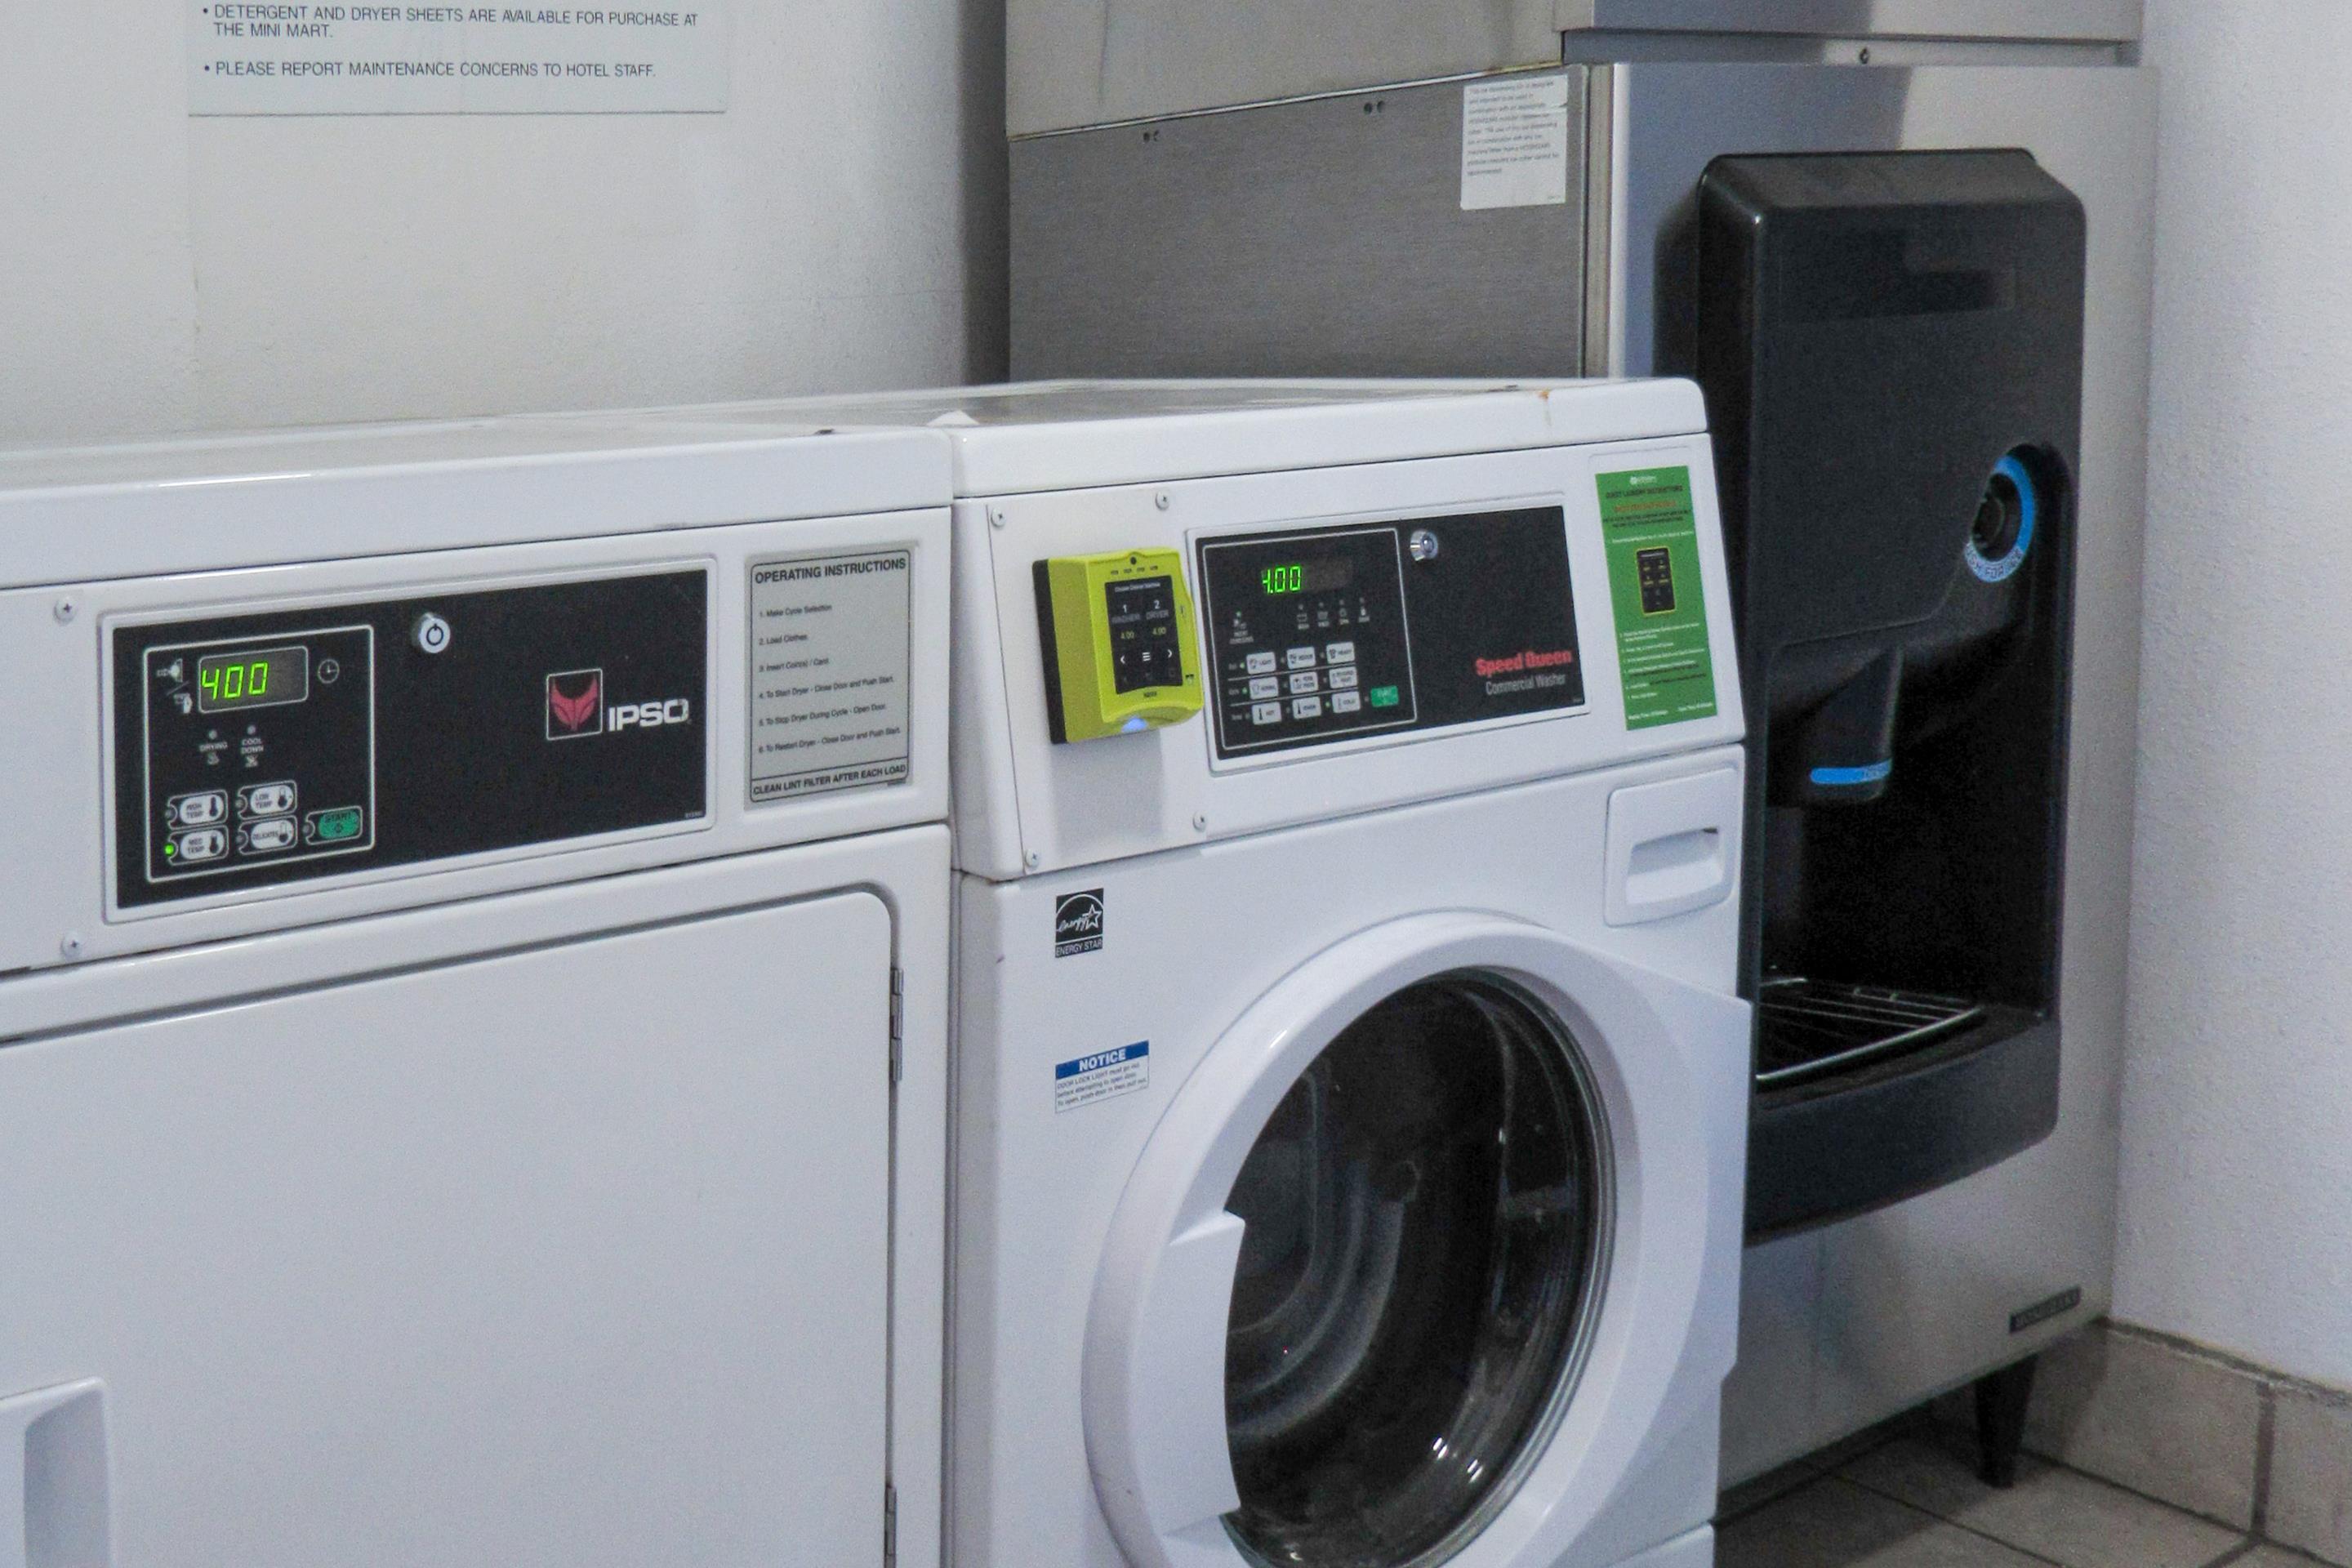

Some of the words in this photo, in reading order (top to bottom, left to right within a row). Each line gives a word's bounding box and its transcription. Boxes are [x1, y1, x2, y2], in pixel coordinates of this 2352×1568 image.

[214, 5, 308, 20] DETERGENT
[314, 6, 345, 20] AND
[351, 7, 401, 21] DRYER
[406, 7, 464, 22] SHEETS
[468, 9, 497, 23] ARE
[502, 10, 572, 24] AVAILABLE
[576, 11, 604, 24] FOR
[608, 12, 679, 26] PURCHASE
[684, 13, 698, 26] AT
[213, 22, 244, 37] THE
[250, 23, 281, 37] MINI
[286, 24, 334, 38] MART.
[216, 61, 276, 76] PLEASE
[282, 62, 343, 76] REPORT
[349, 62, 455, 76] MAINTENANCE
[460, 62, 539, 77] CONCERNS
[543, 63, 562, 77] TO
[566, 64, 609, 78] HOTEL
[614, 64, 657, 78] STAFF.
[755, 566, 822, 584] OPERATING
[824, 558, 906, 577] INSTRUCTIONS
[1153, 599, 1160, 609] 2
[1475, 653, 1524, 679] Speed
[1524, 650, 1573, 668] Queen
[1486, 675, 1535, 696] Commercial
[1535, 673, 1566, 688] Washer
[608, 698, 689, 732] IPSO
[753, 782, 782, 795] CLEAN
[783, 779, 802, 791] LINT
[803, 775, 831, 788] FILTER
[832, 772, 860, 783] AFTER
[861, 768, 884, 779] EACH
[884, 764, 906, 776] LOAD
[1056, 942, 1084, 956] ENERGY
[1084, 938, 1103, 951] STAR
[1078, 1048, 1126, 1072] NOTICE
